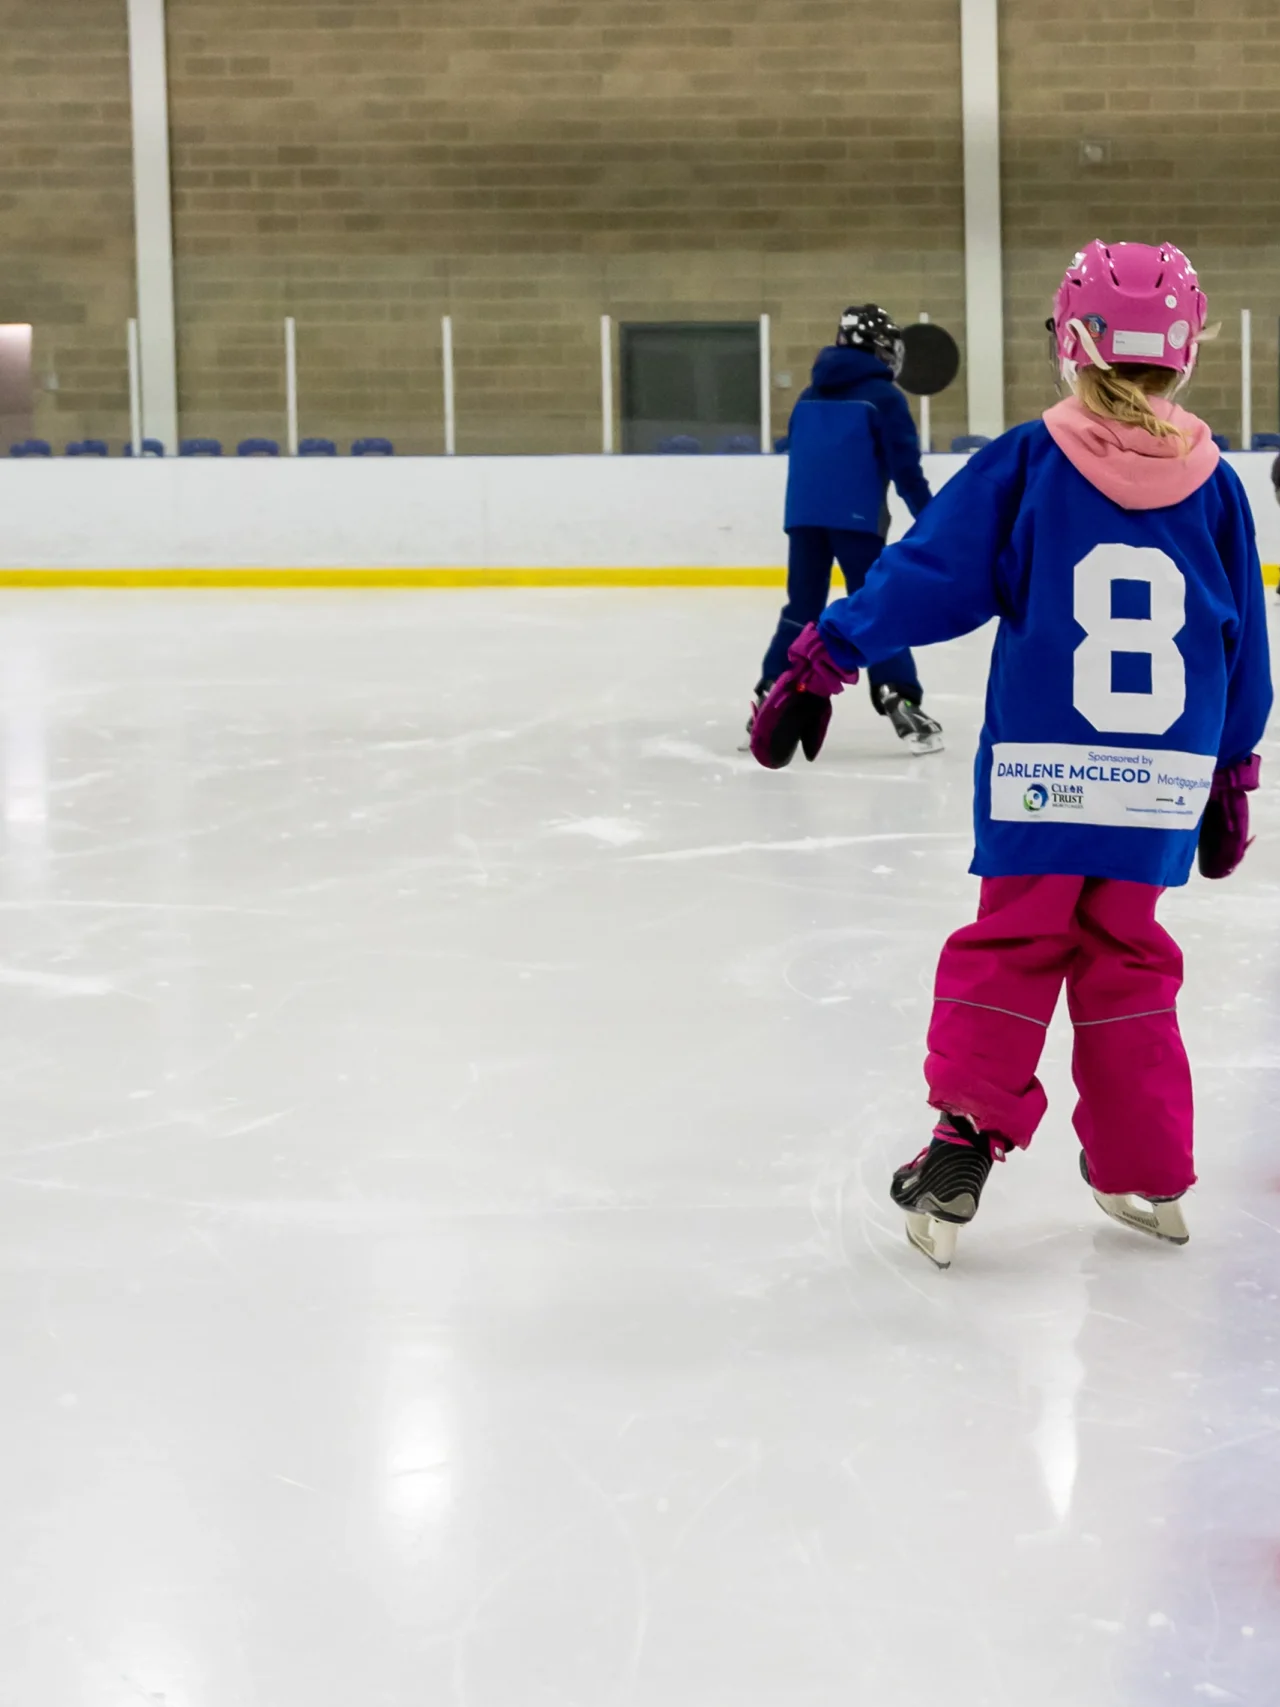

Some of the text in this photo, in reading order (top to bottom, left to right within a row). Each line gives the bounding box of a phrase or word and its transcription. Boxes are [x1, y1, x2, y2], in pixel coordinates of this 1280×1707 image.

[1072, 542, 1186, 735] 8
[1088, 752, 1154, 766] Sponsored by
[997, 763, 1064, 778] DARLENE
[1069, 765, 1151, 783] MCLEOD
[1052, 793, 1084, 804] TRUST
